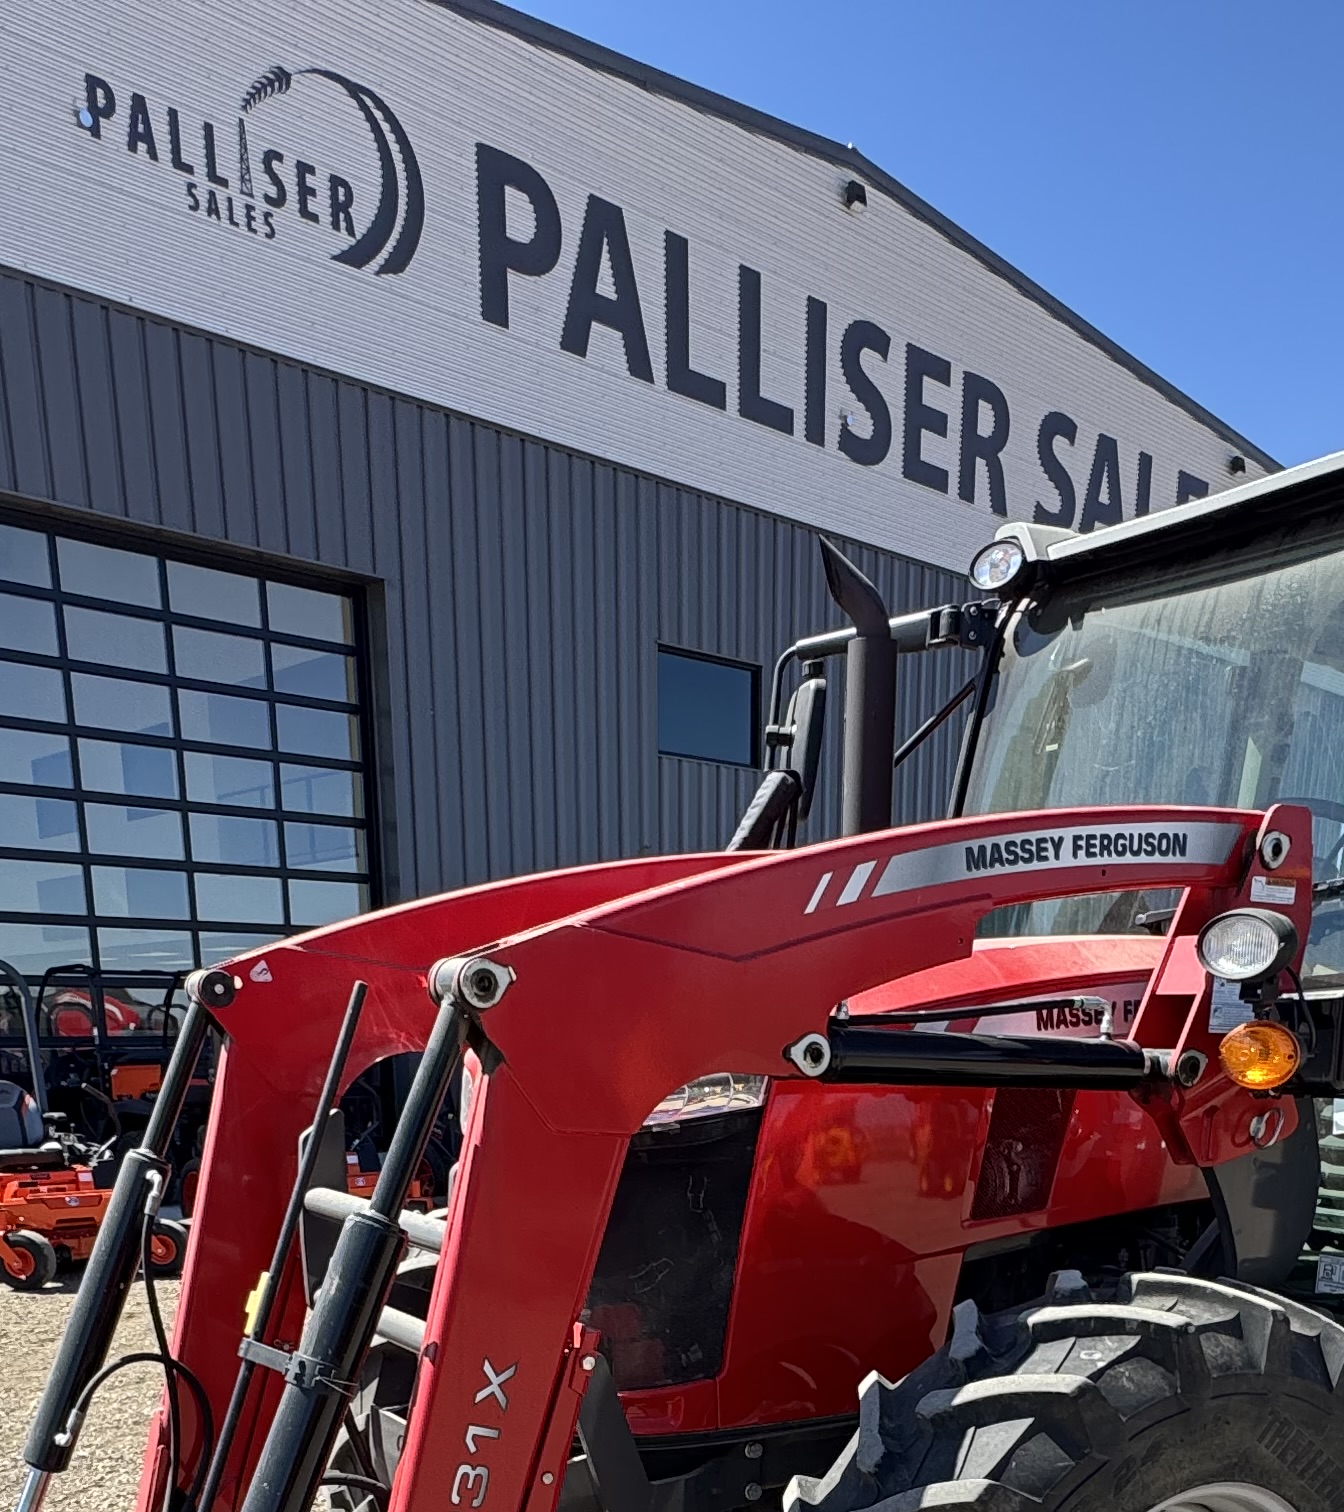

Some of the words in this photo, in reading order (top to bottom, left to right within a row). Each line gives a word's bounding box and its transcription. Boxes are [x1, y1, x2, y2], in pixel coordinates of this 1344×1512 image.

[80, 73, 357, 239] PALLISER
[186, 181, 276, 240] SALES
[475, 142, 1011, 517] PALLISER
[965, 834, 1065, 873] MASSEY
[1071, 831, 1189, 860] FERGUSON
